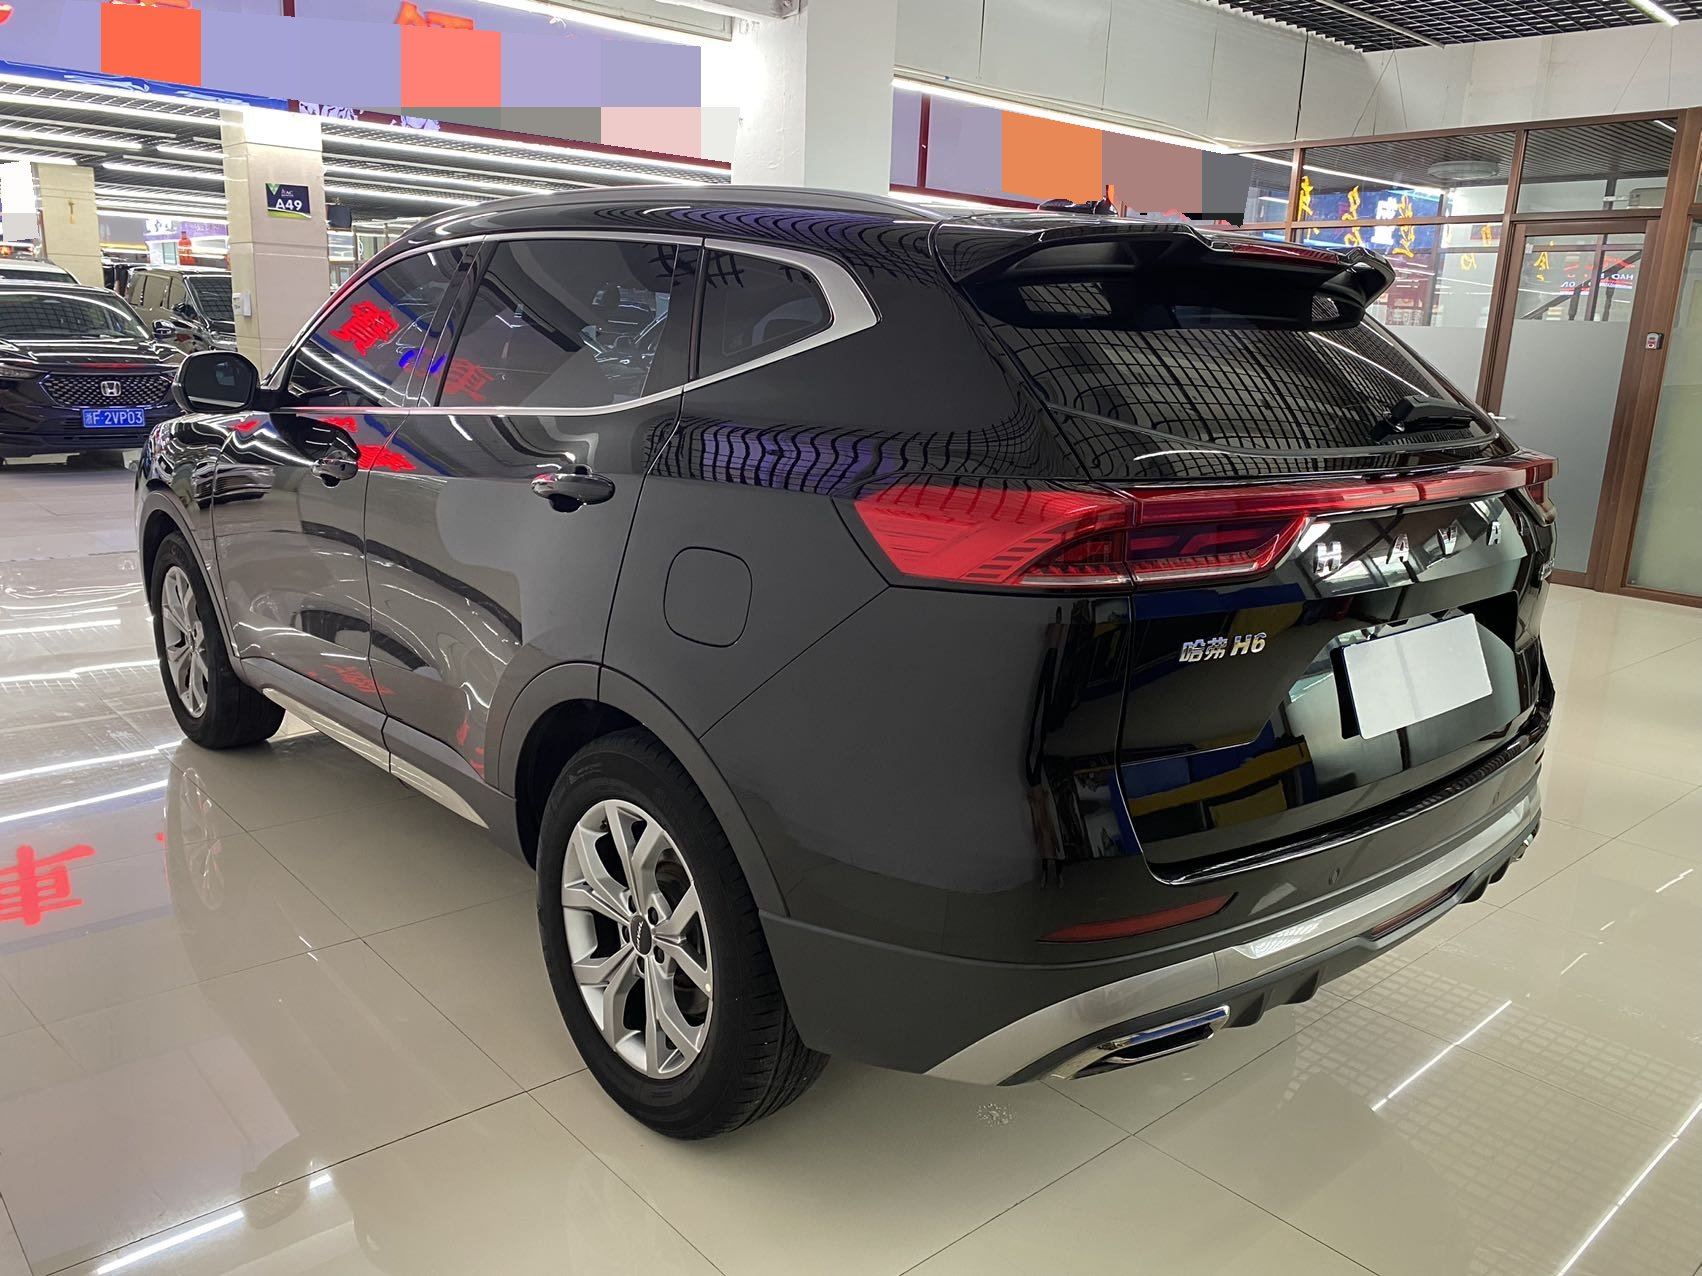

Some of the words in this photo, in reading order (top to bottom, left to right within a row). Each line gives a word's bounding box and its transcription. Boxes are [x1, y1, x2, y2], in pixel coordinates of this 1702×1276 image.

[275, 198, 303, 211] A49
[1179, 636, 1228, 662] 哈弗
[1230, 632, 1267, 656] H6
